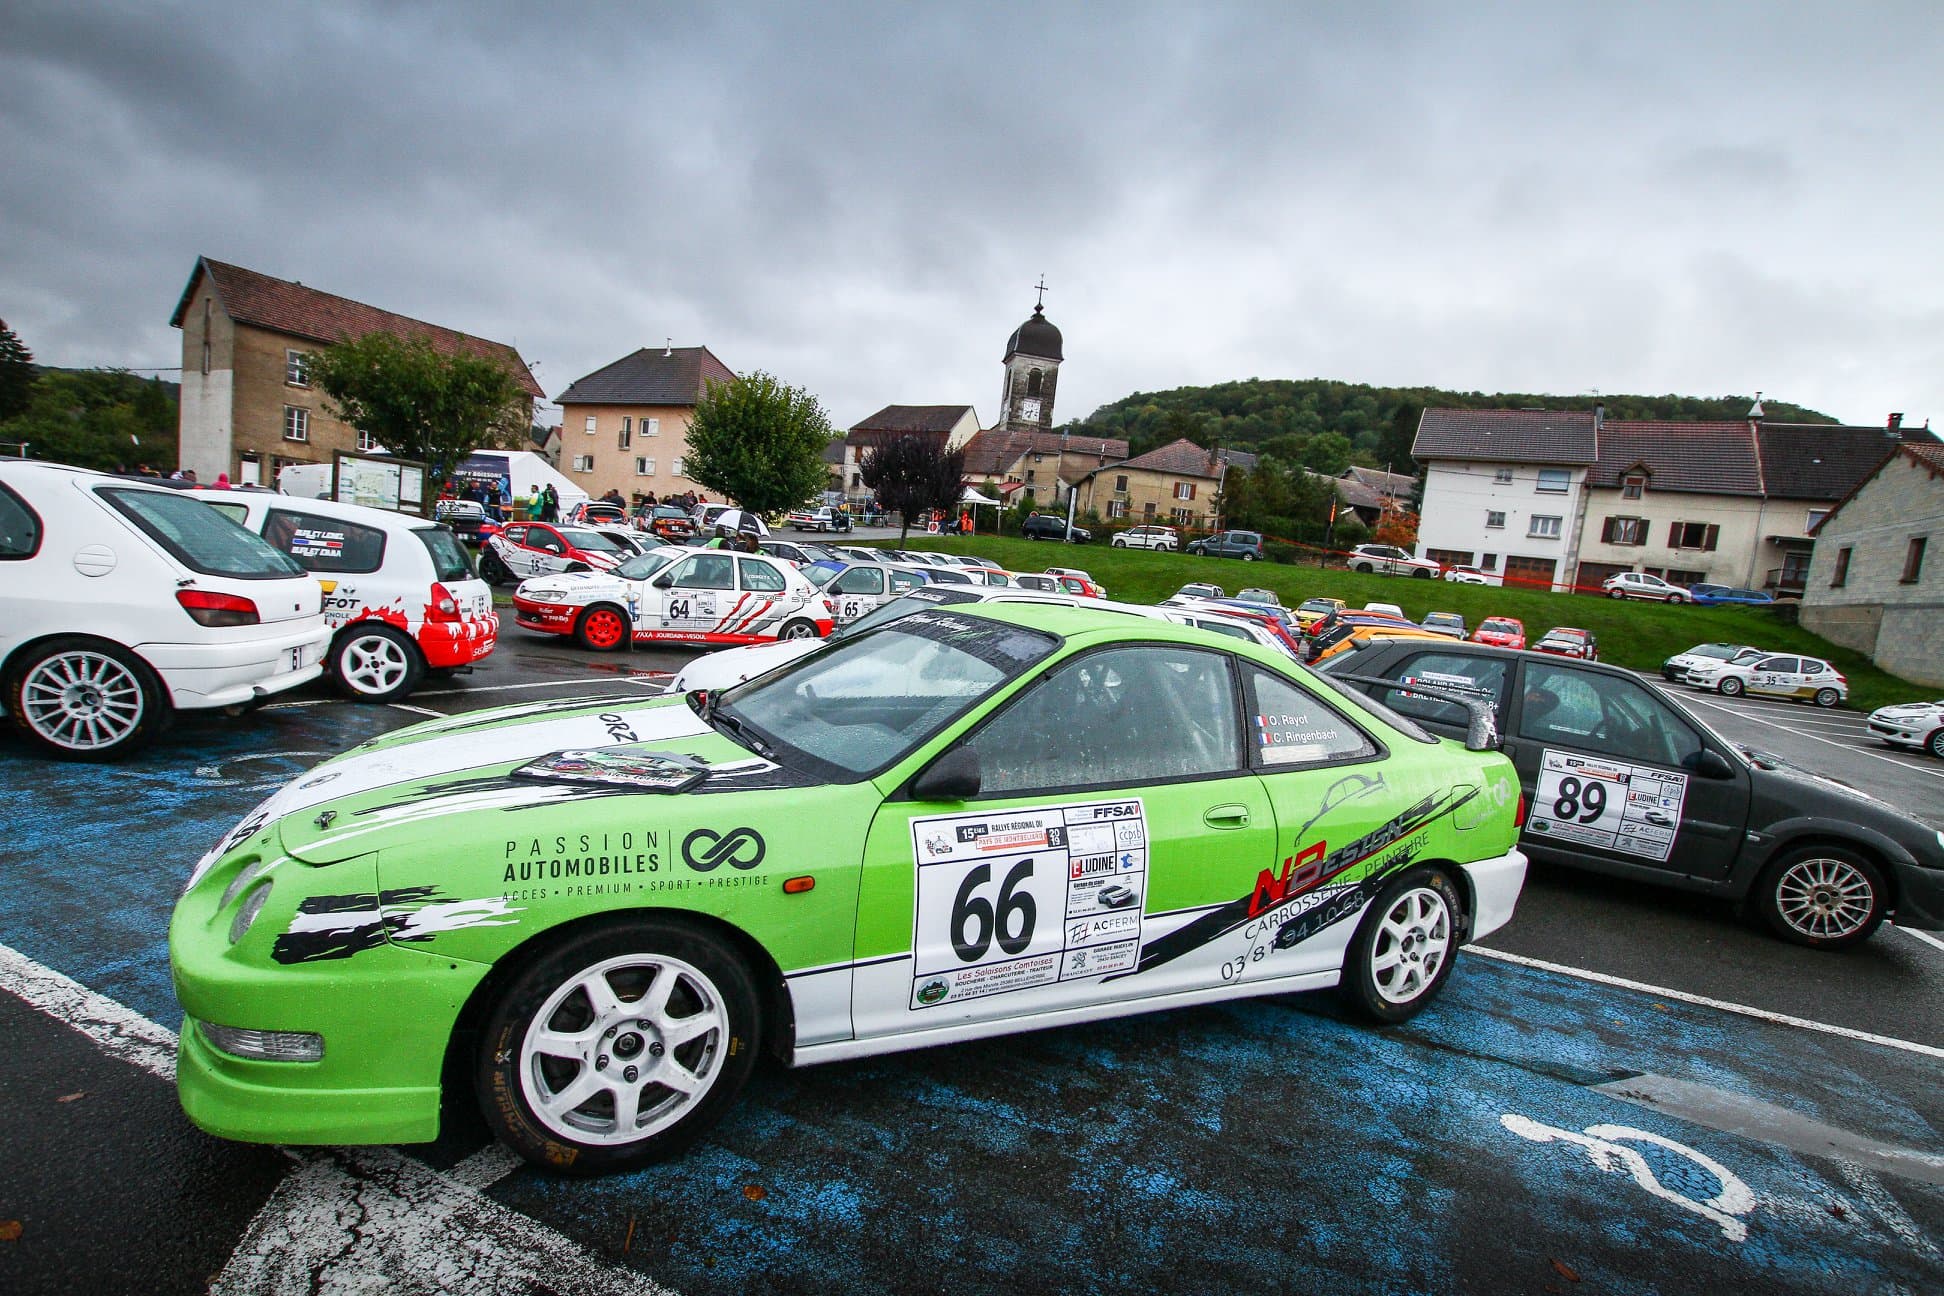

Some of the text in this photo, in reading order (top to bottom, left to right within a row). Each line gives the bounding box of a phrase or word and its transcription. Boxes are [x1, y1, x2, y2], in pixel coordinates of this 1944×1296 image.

[670, 599, 690, 619] 64
[844, 601, 859, 617] 65
[1766, 676, 1776, 686] 35
[1281, 714, 1309, 727] Rayot
[1273, 729, 1338, 743] C. Ringenbach
[1553, 776, 1607, 824] 89
[1093, 805, 1135, 819] FFSA
[506, 831, 658, 859] PASSION
[503, 854, 660, 882] AUTOMOBILES
[1072, 856, 1115, 875] ELUDINE
[502, 875, 769, 902] ACCES PREMIUM SPORT PRESTIGE
[1245, 831, 1430, 940] CARROSSERIE PEINTURE
[950, 858, 1037, 963] 66
[1093, 915, 1138, 932] ACFERM
[1221, 890, 1365, 981] 03 81 94 10 68
[954, 978, 986, 987] BOUCHERIE
[989, 970, 1026, 981] CHARCUTERIE
[1029, 965, 1054, 974] TRAITEUR
[957, 957, 1054, 981] Les Salaisons Comtoises
